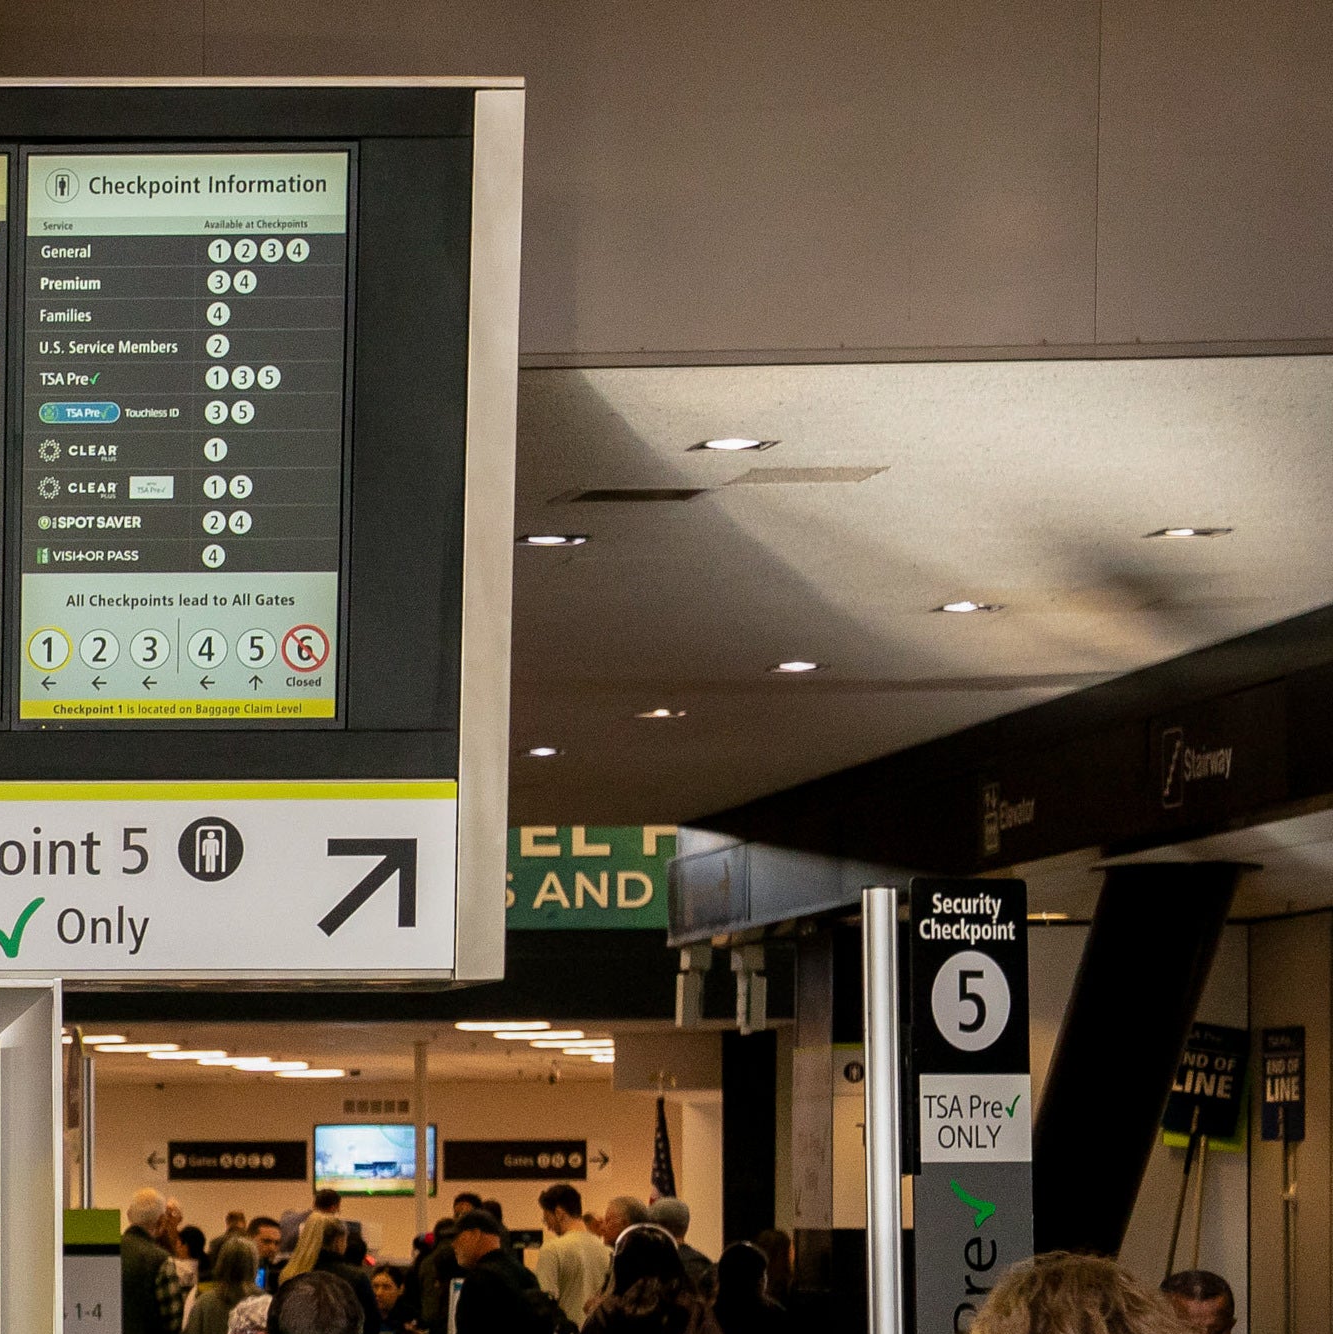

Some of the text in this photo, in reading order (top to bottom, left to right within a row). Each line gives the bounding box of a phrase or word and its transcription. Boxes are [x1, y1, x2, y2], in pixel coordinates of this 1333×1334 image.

[89, 174, 327, 198] Checkpoint Information
[43, 219, 308, 231] Service Available at Checkpoints
[41, 243, 302, 258] General 1 2 3 4
[40, 275, 249, 290] Premium 3 4
[40, 306, 223, 322] Families 4
[40, 339, 222, 354] U.S. Service Members 2
[40, 372, 64, 385] TSA
[213, 371, 221, 385] 1
[239, 370, 248, 385] 3
[265, 370, 274, 385] 5
[65, 408, 82, 417] TSA
[125, 408, 166, 418] Touchless
[169, 408, 179, 417] ID
[212, 405, 221, 420] 3
[238, 405, 247, 420] 5
[68, 443, 219, 457] CLEAR 1
[68, 480, 245, 494] CLEAR 1 5
[58, 515, 245, 530] SPOT SAVER 2 4
[107, 550, 139, 560] PASS
[208, 549, 218, 563] 4
[66, 594, 295, 609] All Checkpoints lead to All Gates
[42, 636, 312, 662] 1 2 3 4 5 6
[286, 676, 321, 687] Closed
[53, 703, 302, 716] Checkpoint 1 is located on Baggage Claim Level
[1184, 746, 1233, 781] Stairway
[122, 827, 149, 874] 5
[533, 871, 653, 909] AND
[932, 892, 1001, 919] Security
[57, 906, 149, 954] Only
[919, 918, 1015, 945] Checkpoint
[959, 970, 986, 1032] 5
[1183, 1053, 1208, 1068] ND
[1172, 1070, 1233, 1099] LINE
[1266, 1076, 1300, 1102] LINE
[923, 1095, 963, 1118] TSA
[938, 1125, 1001, 1148] ONLY
[75, 1303, 101, 1320] 1-4
